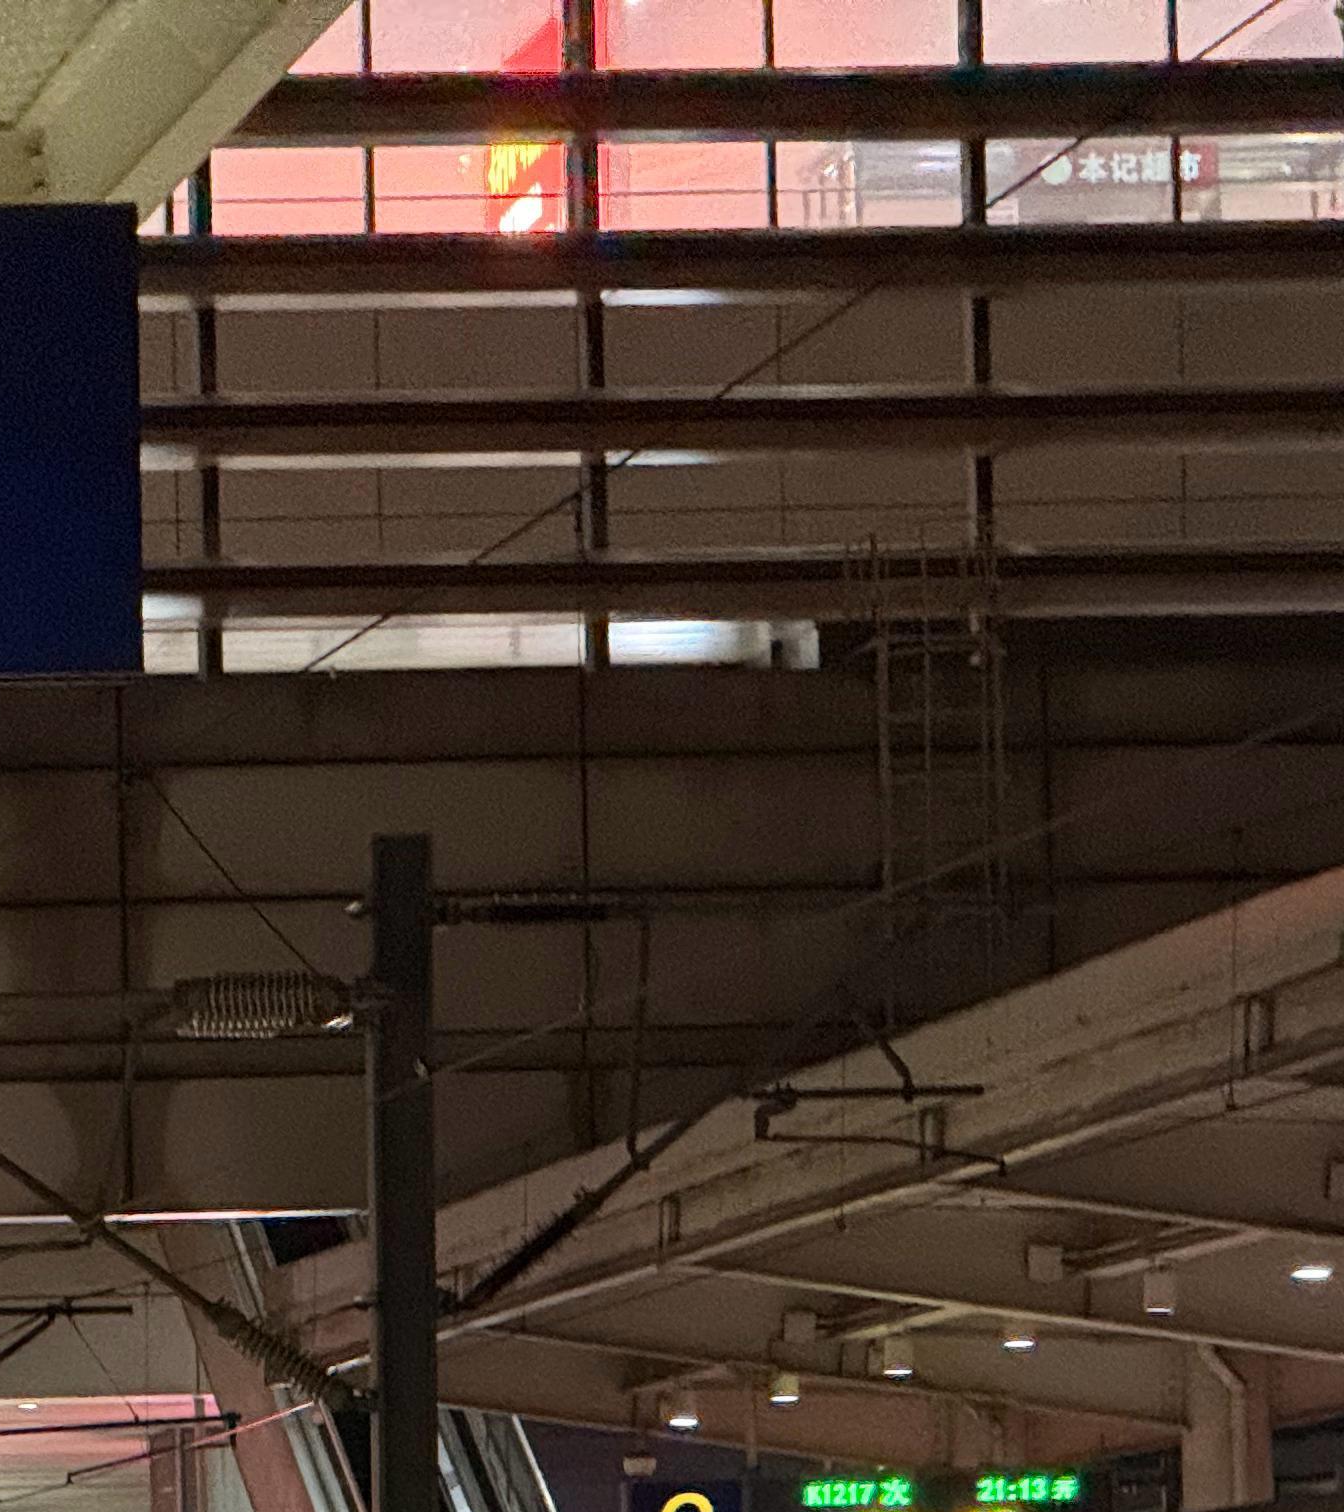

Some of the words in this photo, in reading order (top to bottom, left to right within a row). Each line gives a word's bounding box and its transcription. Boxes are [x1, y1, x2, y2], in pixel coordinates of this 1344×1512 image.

[803, 1483, 876, 1507] K1217
[881, 1479, 910, 1507] 次
[976, 1478, 1047, 1502] 21:13
[1051, 1478, 1078, 1501] 开
